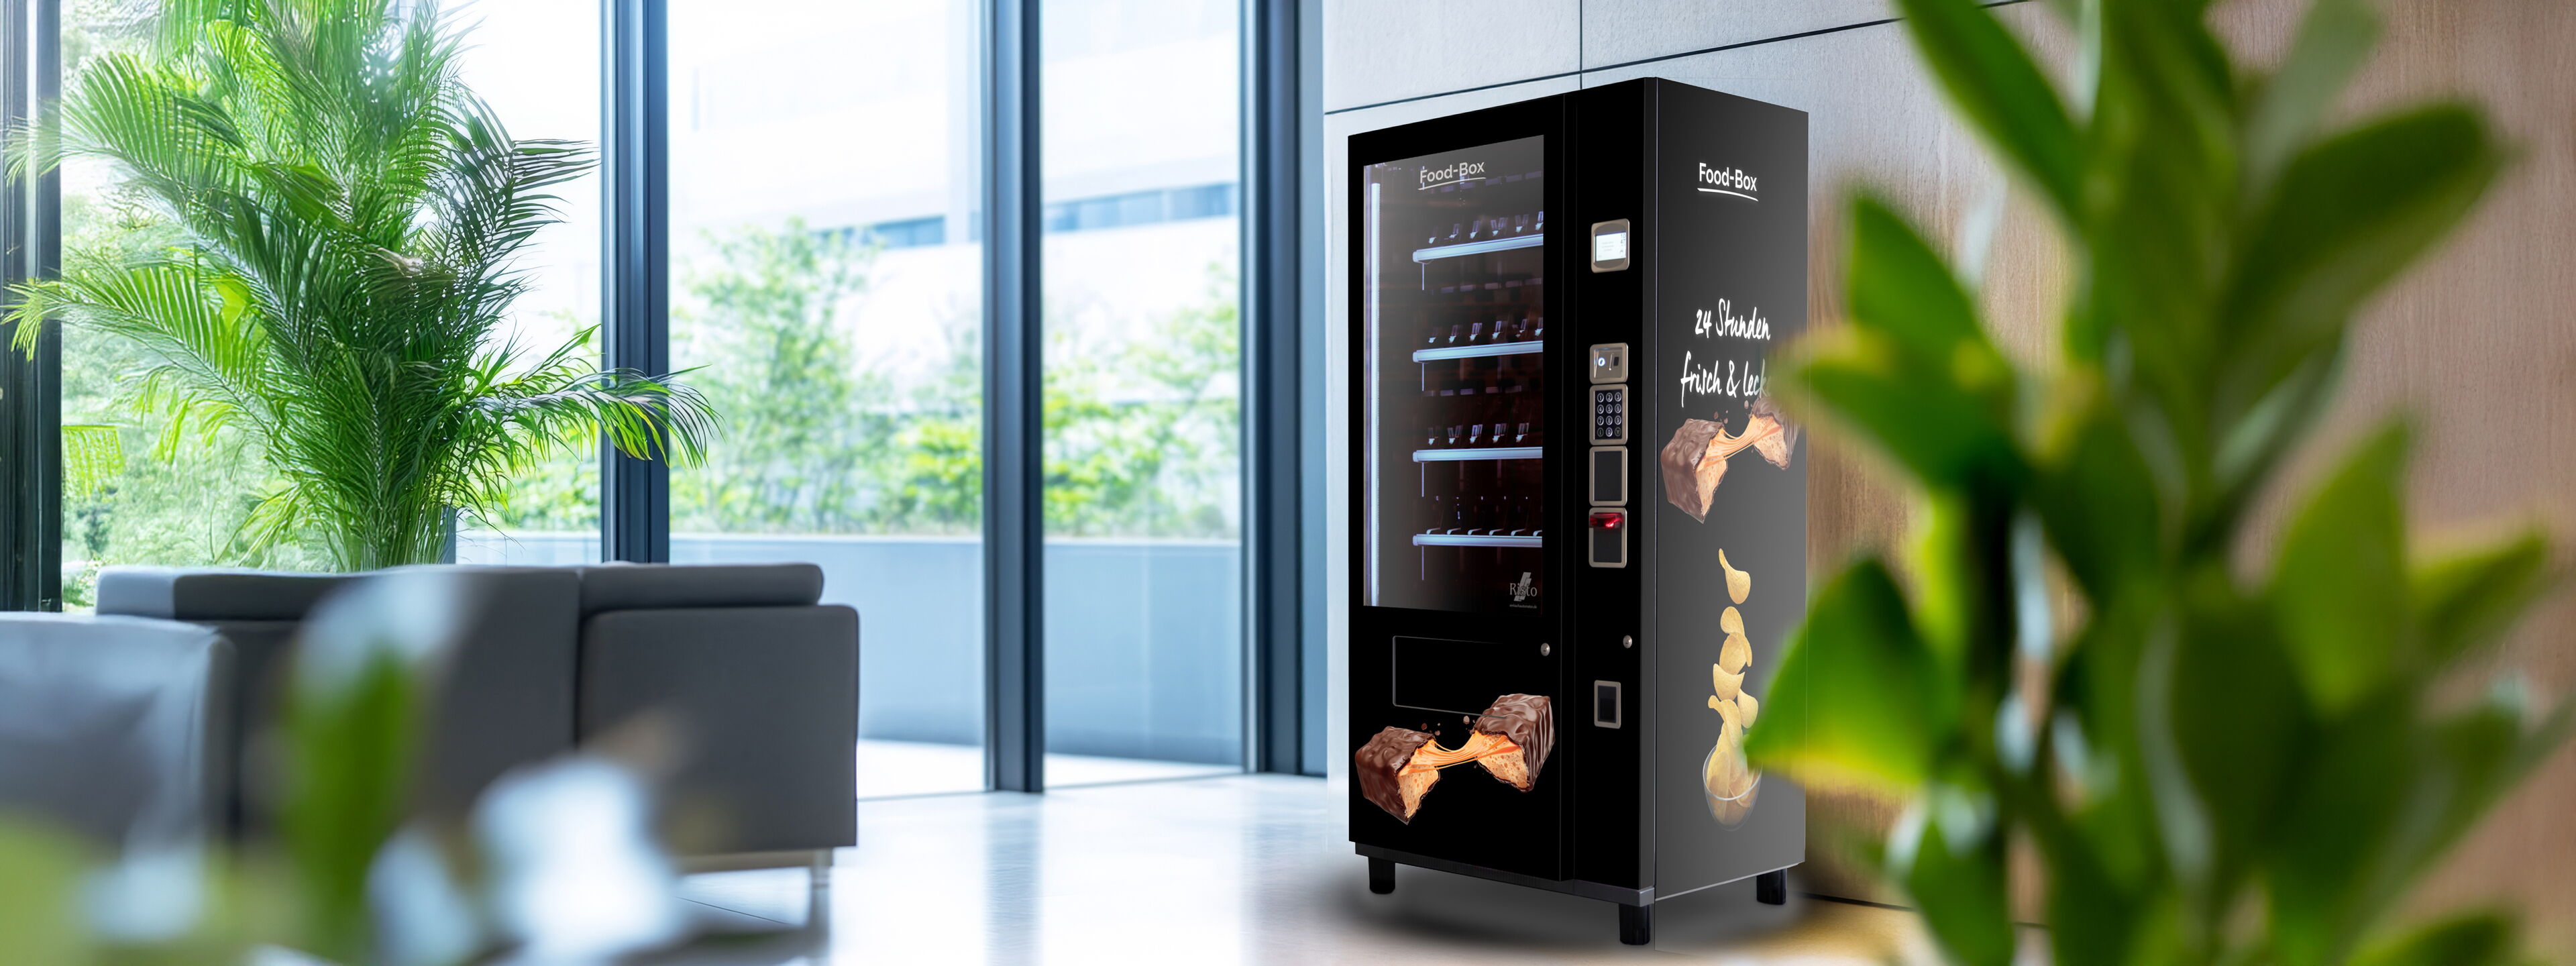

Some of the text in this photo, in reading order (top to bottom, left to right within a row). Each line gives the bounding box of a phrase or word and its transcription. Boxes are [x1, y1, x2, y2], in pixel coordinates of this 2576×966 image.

[1420, 162, 1485, 184] Food-Box
[1699, 162, 1757, 191] Food-Box
[1695, 298, 1771, 341] 24 Stunden
[1680, 350, 1771, 408] frisch & leck
[1509, 582, 1538, 597] Risto
